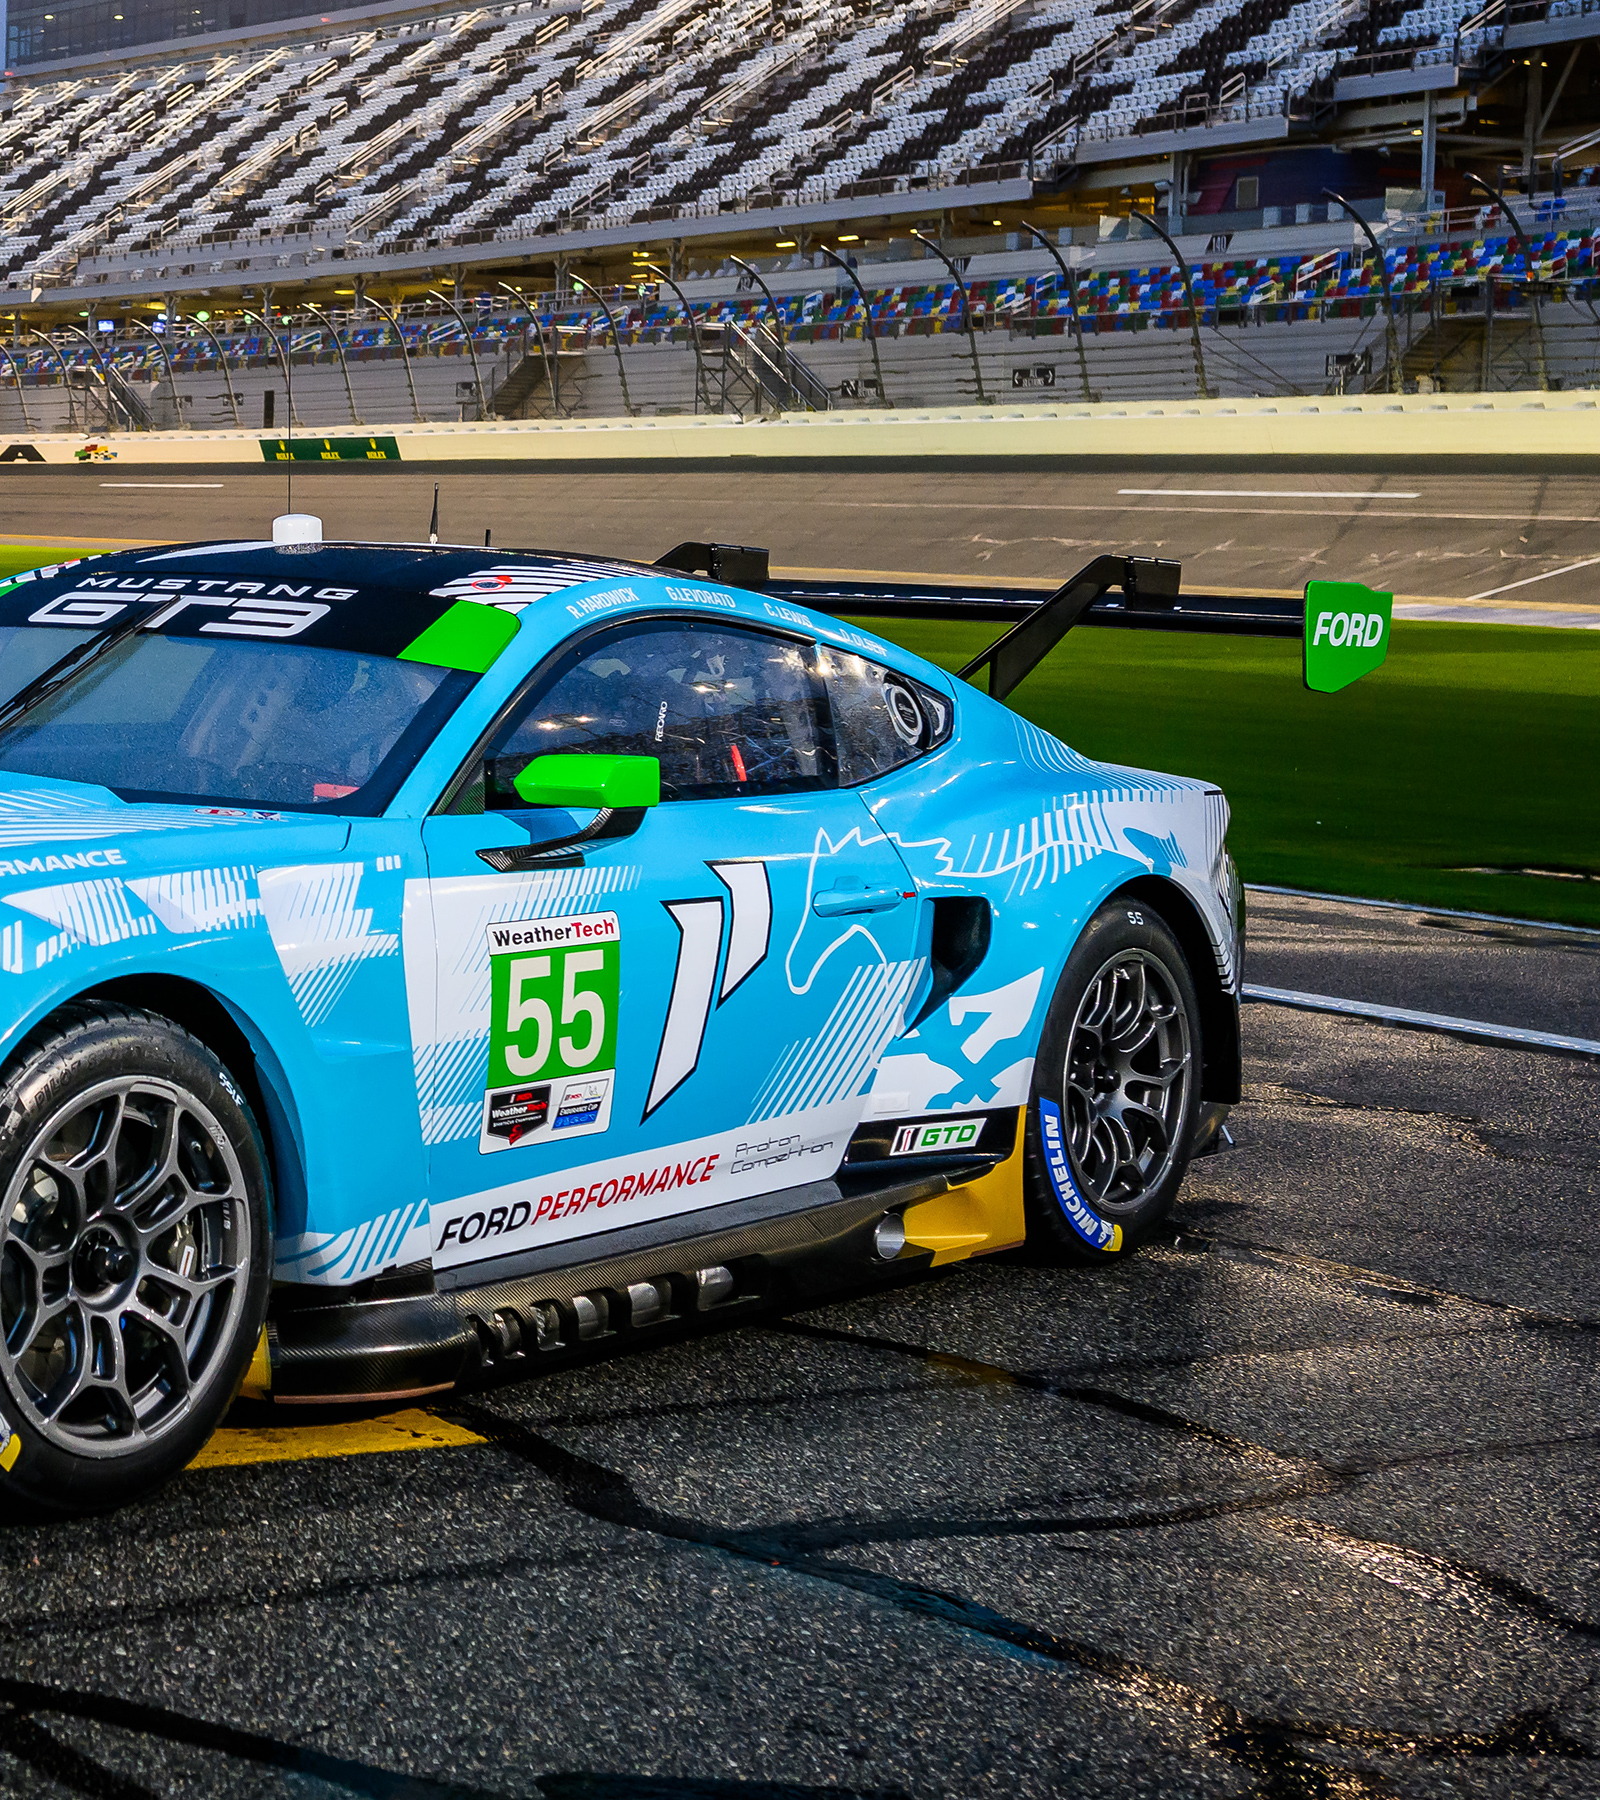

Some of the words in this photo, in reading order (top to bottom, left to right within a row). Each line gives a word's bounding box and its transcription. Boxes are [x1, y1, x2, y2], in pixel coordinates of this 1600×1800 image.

[320, 451, 341, 460] ROLEX
[366, 451, 387, 459] ROLEX
[76, 576, 360, 601] MUSTANG
[27, 591, 332, 638] GT3
[1312, 611, 1384, 647] FORD
[655, 701, 668, 742] RECARO
[492, 918, 616, 947] WeatherTech
[504, 949, 605, 1077] 55
[920, 1124, 977, 1147] GTD
[1044, 1114, 1099, 1236] MICHELIN
